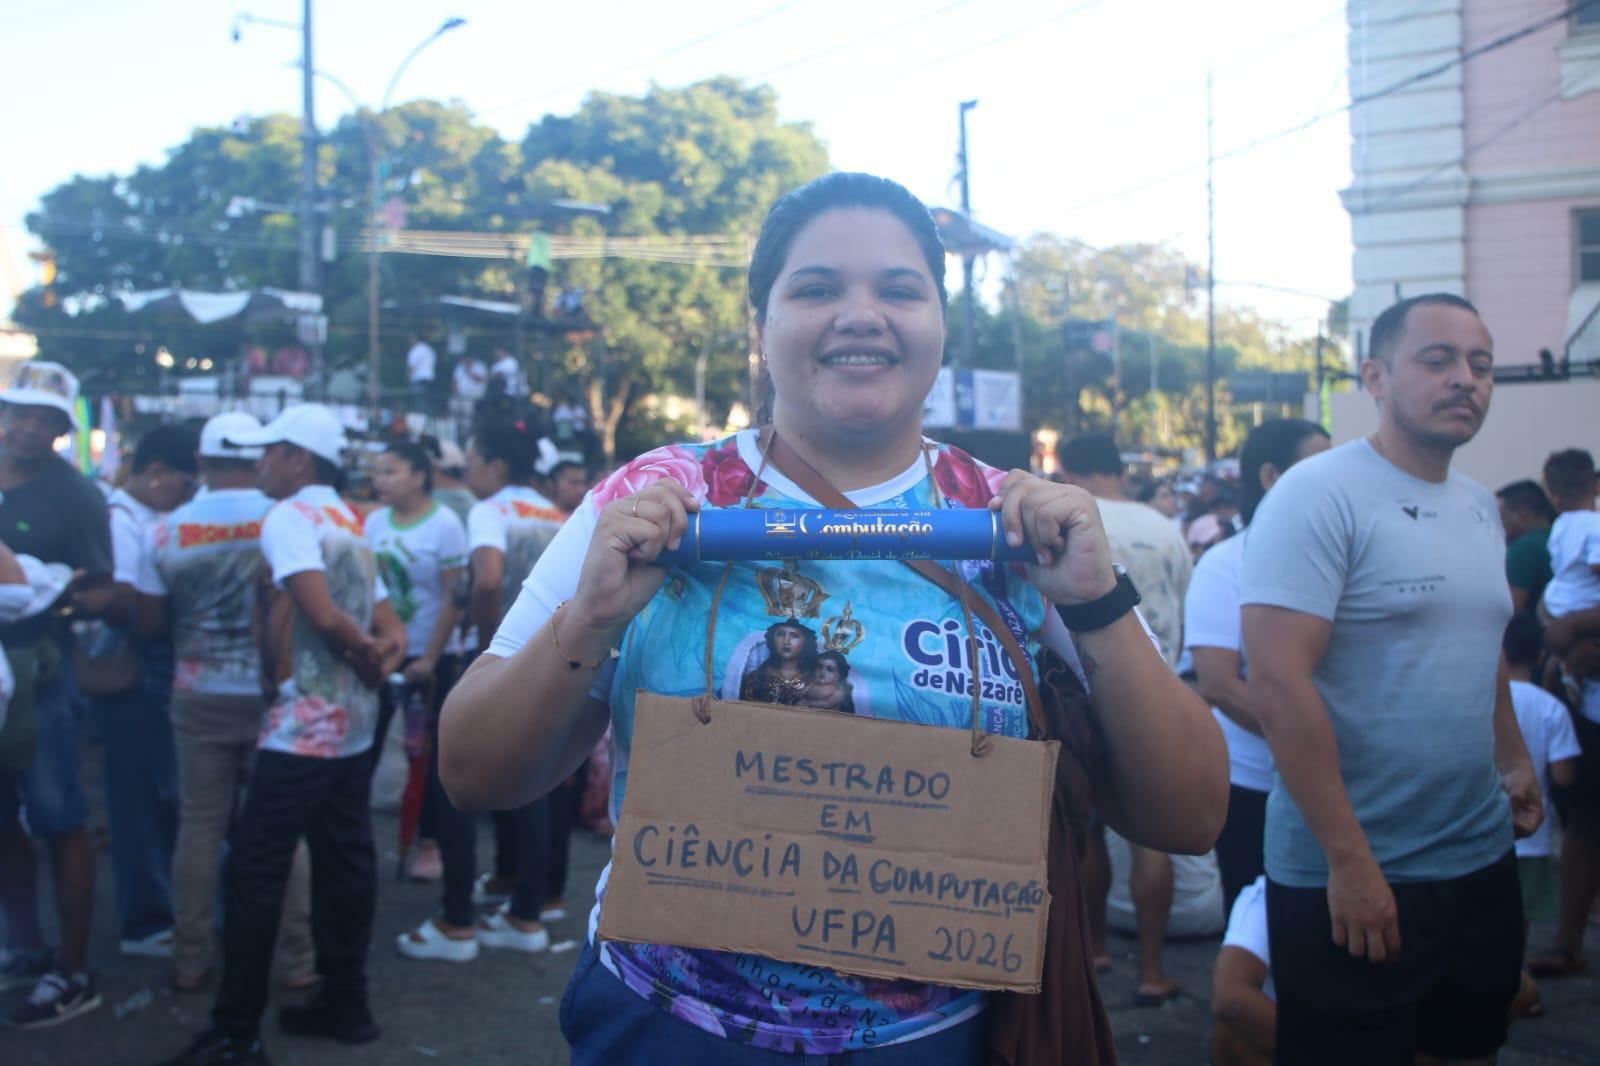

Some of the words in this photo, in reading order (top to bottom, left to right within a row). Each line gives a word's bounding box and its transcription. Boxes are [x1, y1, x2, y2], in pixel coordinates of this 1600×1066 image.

[735, 750, 950, 800] MESTRADO
[820, 803, 872, 833] EM
[823, 851, 858, 885] DA
[868, 858, 1043, 918] COMPUTAÇÃO
[792, 904, 897, 953] UFPA
[927, 926, 1023, 974] 2026
